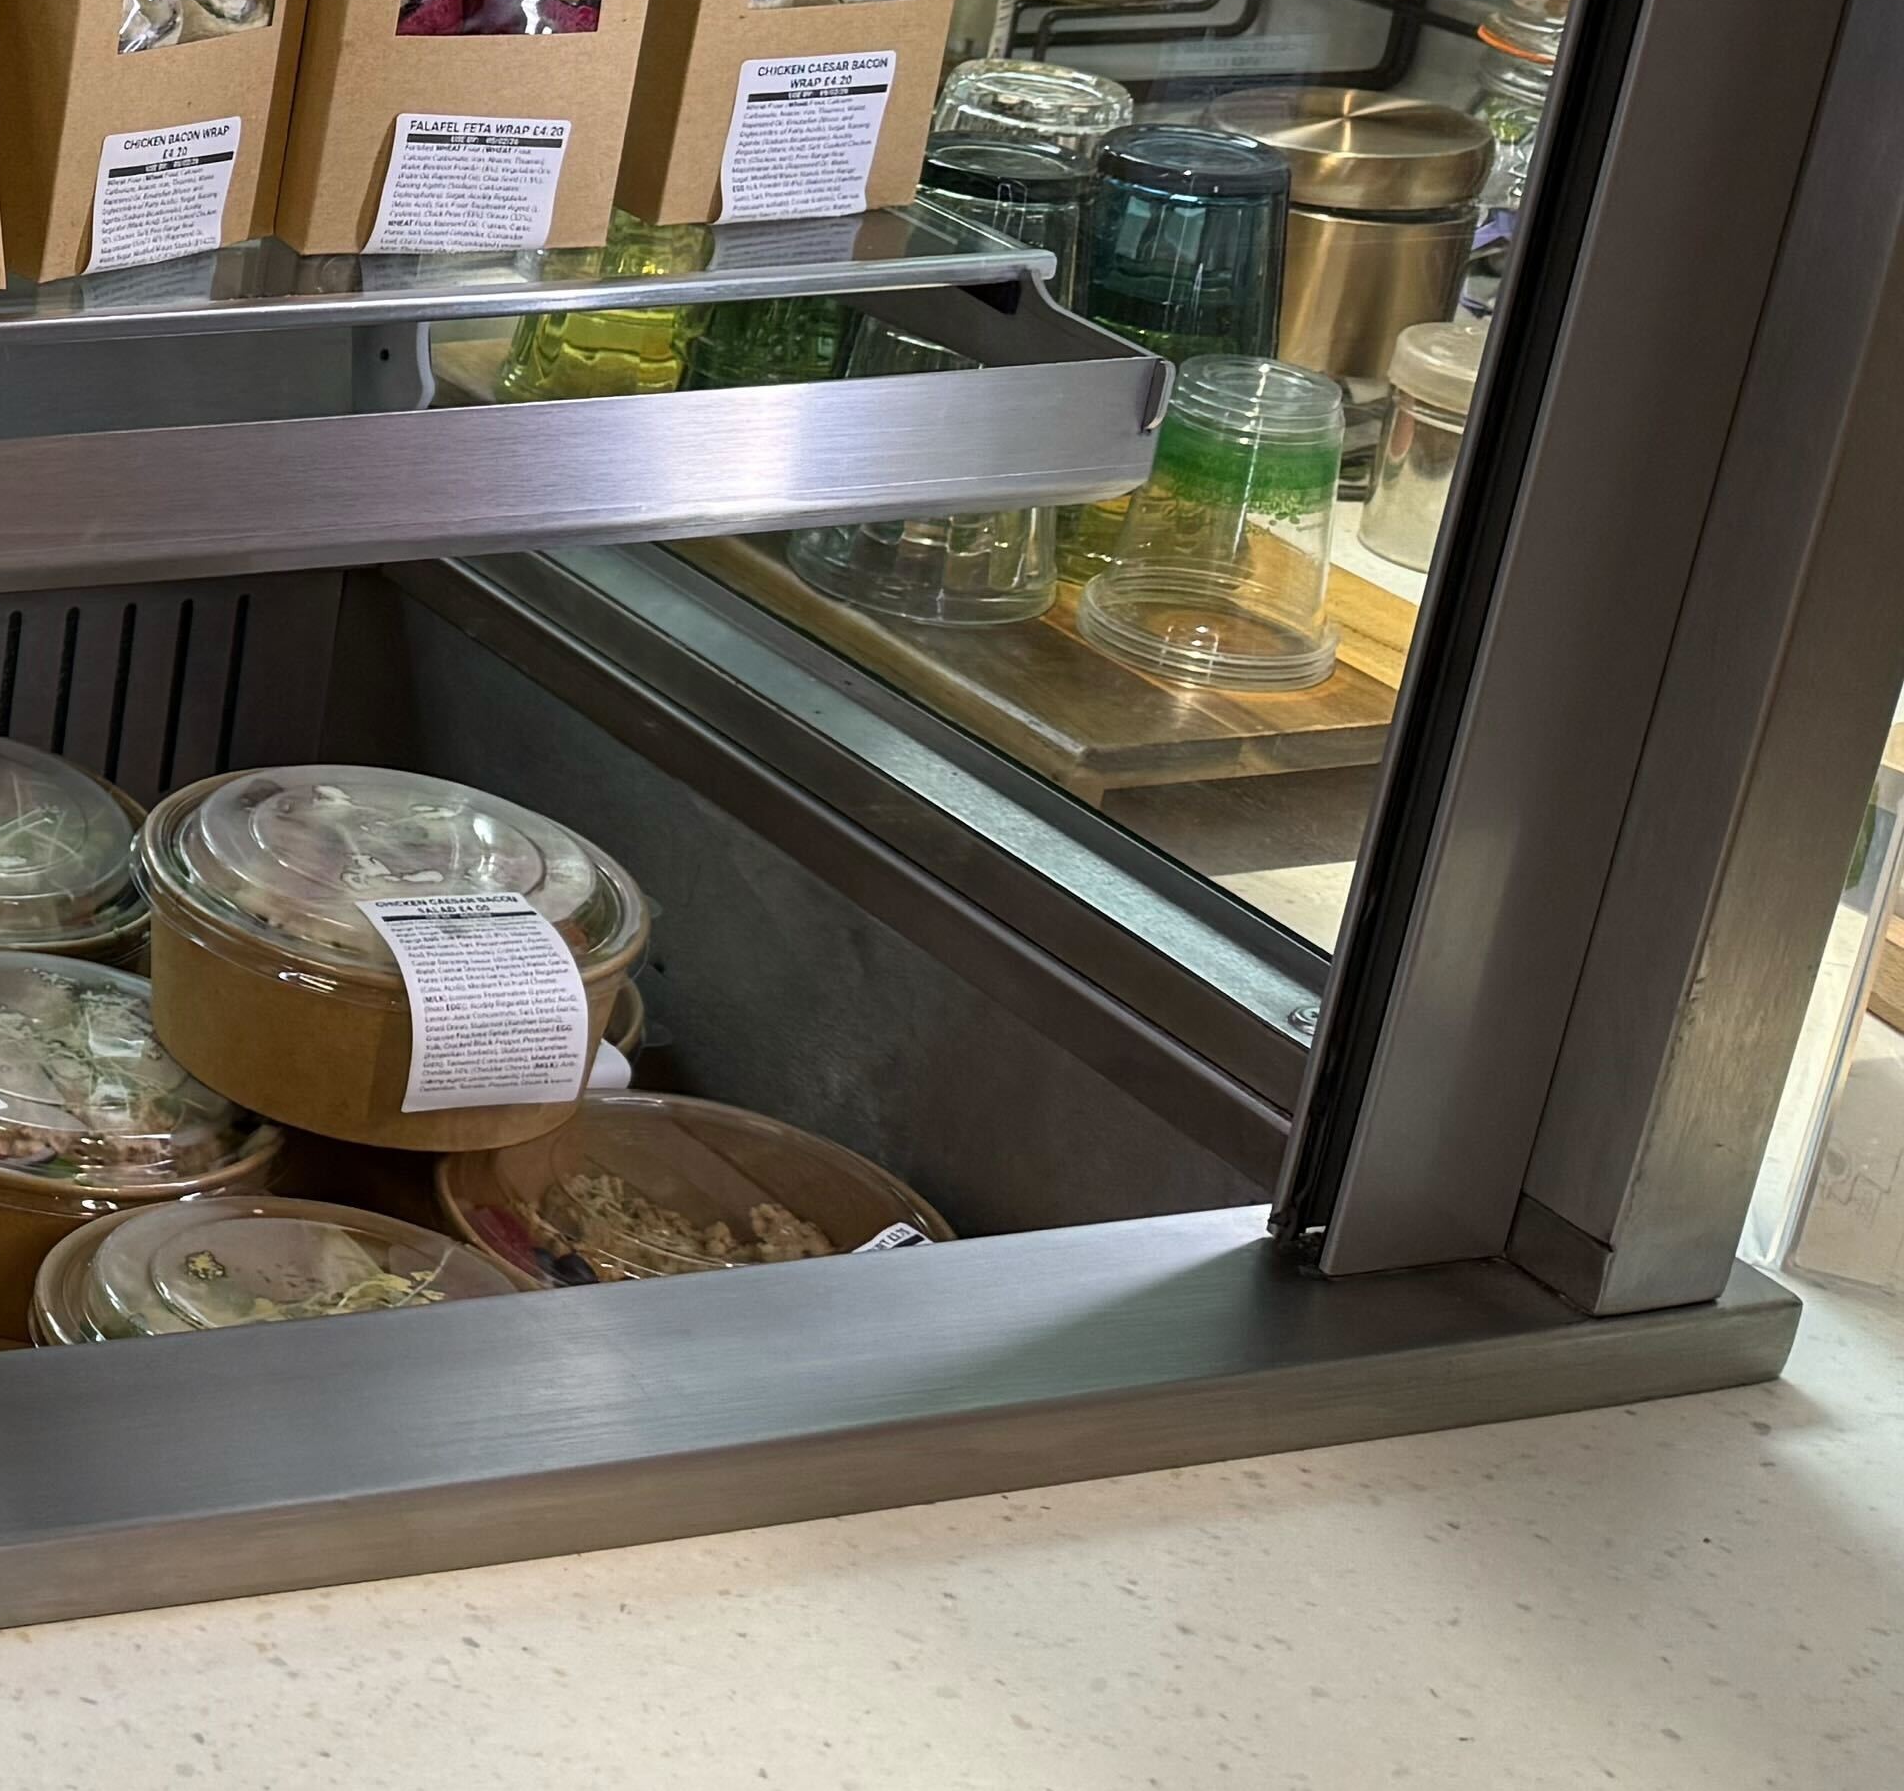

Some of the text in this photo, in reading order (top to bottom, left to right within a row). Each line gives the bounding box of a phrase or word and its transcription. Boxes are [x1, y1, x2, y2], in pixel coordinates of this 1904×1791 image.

[758, 58, 889, 77] CHICKEN CAESAR BACON
[410, 120, 458, 133] FALAFEL
[463, 122, 491, 133] FETA
[495, 123, 530, 135] WRAP
